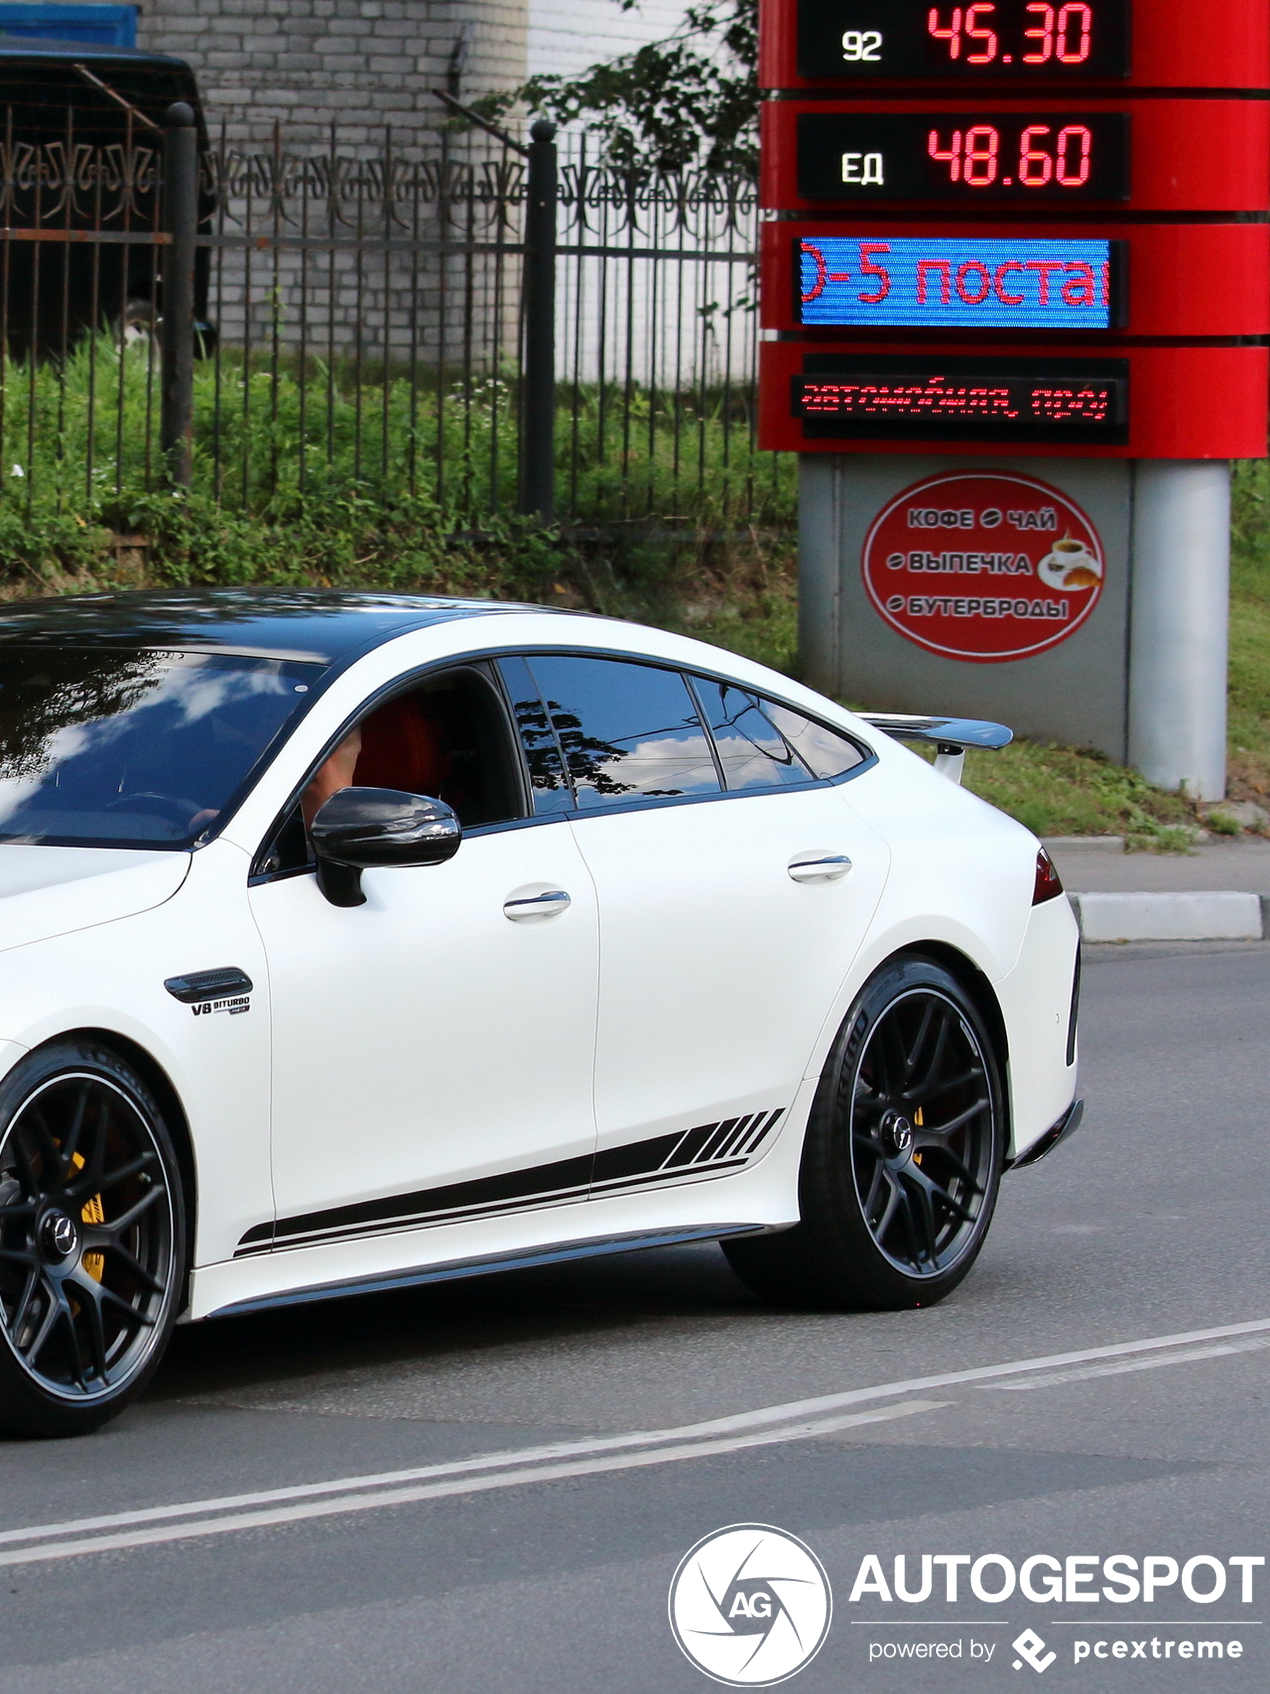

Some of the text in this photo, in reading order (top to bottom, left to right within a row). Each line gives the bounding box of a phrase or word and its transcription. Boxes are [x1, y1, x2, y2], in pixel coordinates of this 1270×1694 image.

[842, 3, 1092, 63] 92 45.30
[841, 125, 1091, 186] ЕД 48.60
[908, 507, 1057, 531] КОФЕ ЧАЙ
[907, 552, 1032, 575] ВЫПЕЧКА
[907, 596, 1068, 619] БУТЕРБРОДЫ
[191, 1003, 212, 1016] V8
